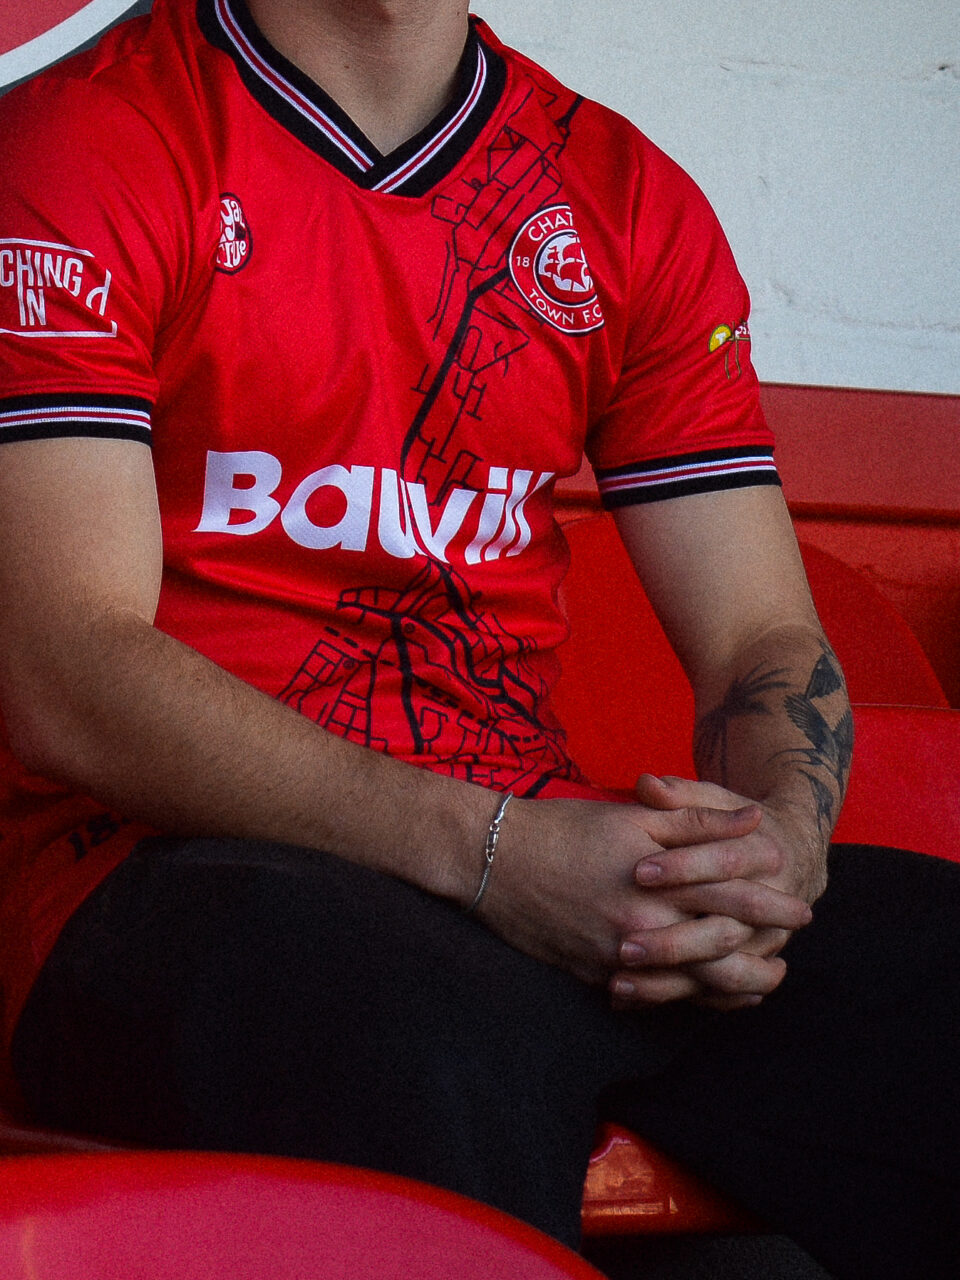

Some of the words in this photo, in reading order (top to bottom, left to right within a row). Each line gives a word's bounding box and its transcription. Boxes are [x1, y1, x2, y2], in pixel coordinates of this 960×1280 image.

[528, 211, 574, 241] CHAT
[515, 256, 530, 268] 18
[18, 288, 47, 327] IN
[529, 288, 575, 325] TOWN
